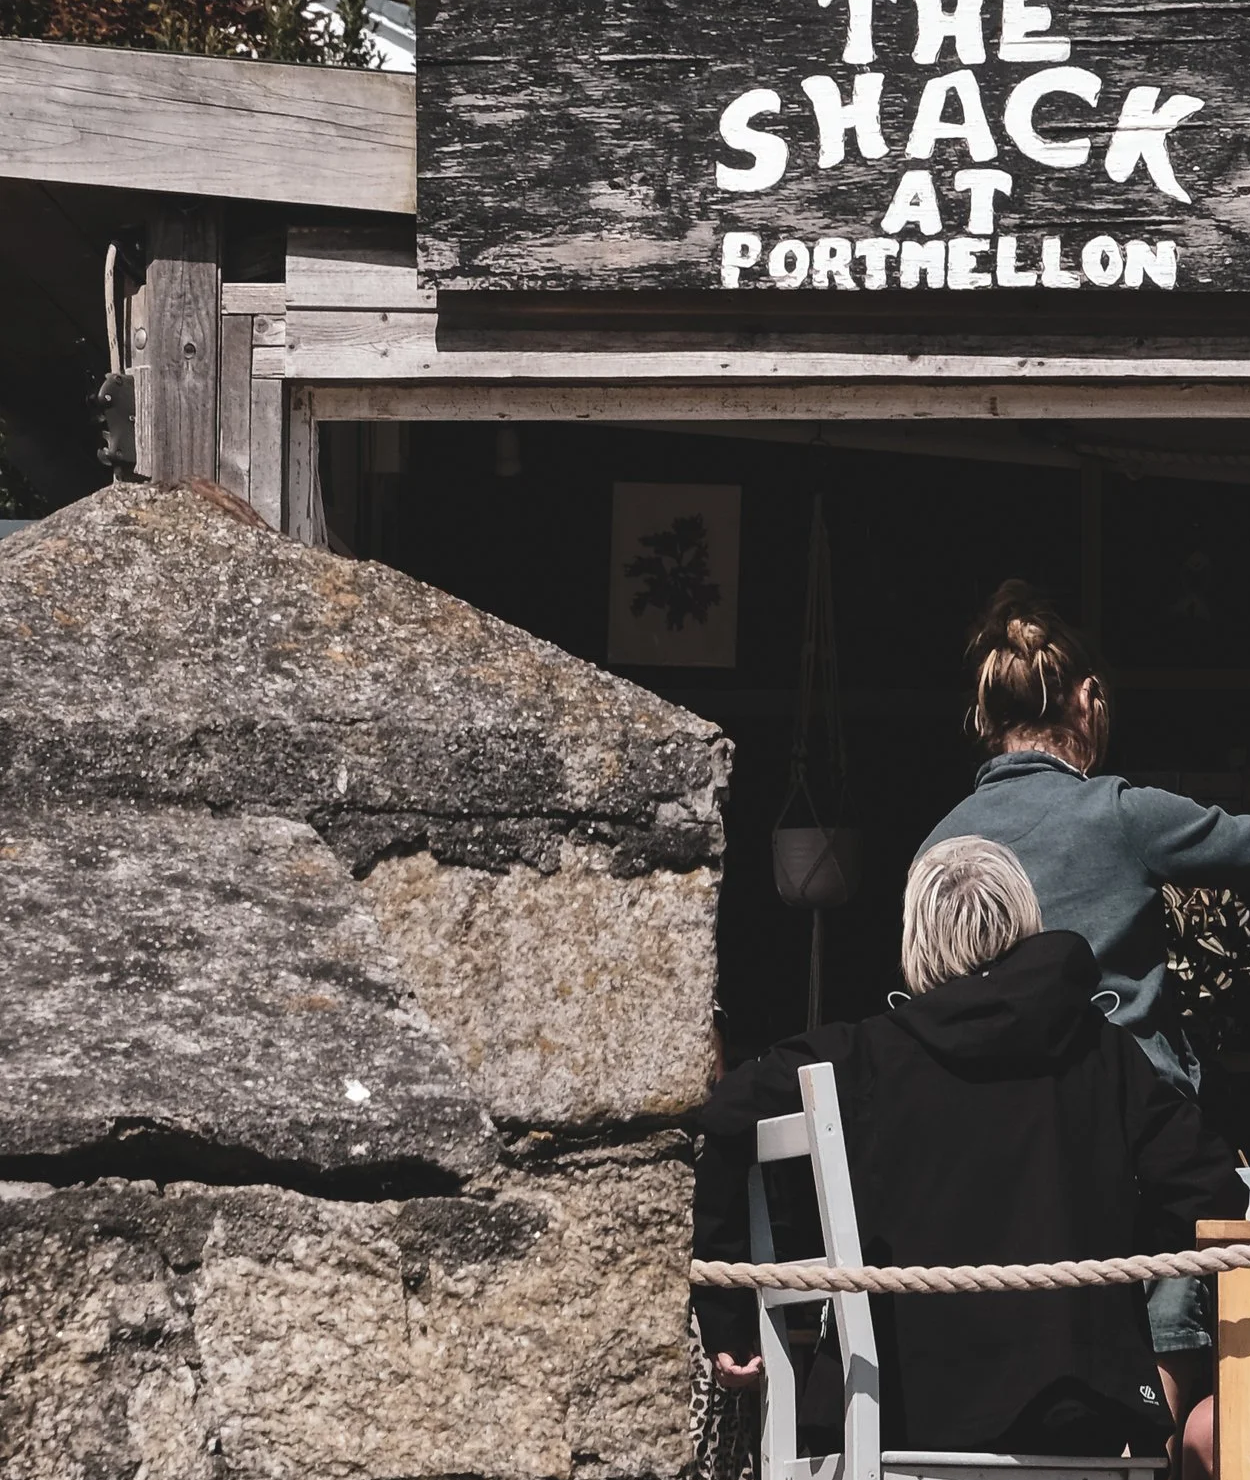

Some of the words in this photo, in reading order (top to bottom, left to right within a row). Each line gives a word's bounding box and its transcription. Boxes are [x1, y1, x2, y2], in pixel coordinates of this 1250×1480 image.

[715, 65, 1206, 205] SHACK
[880, 168, 1013, 236] AT
[720, 231, 1177, 290] PORTMELLON
